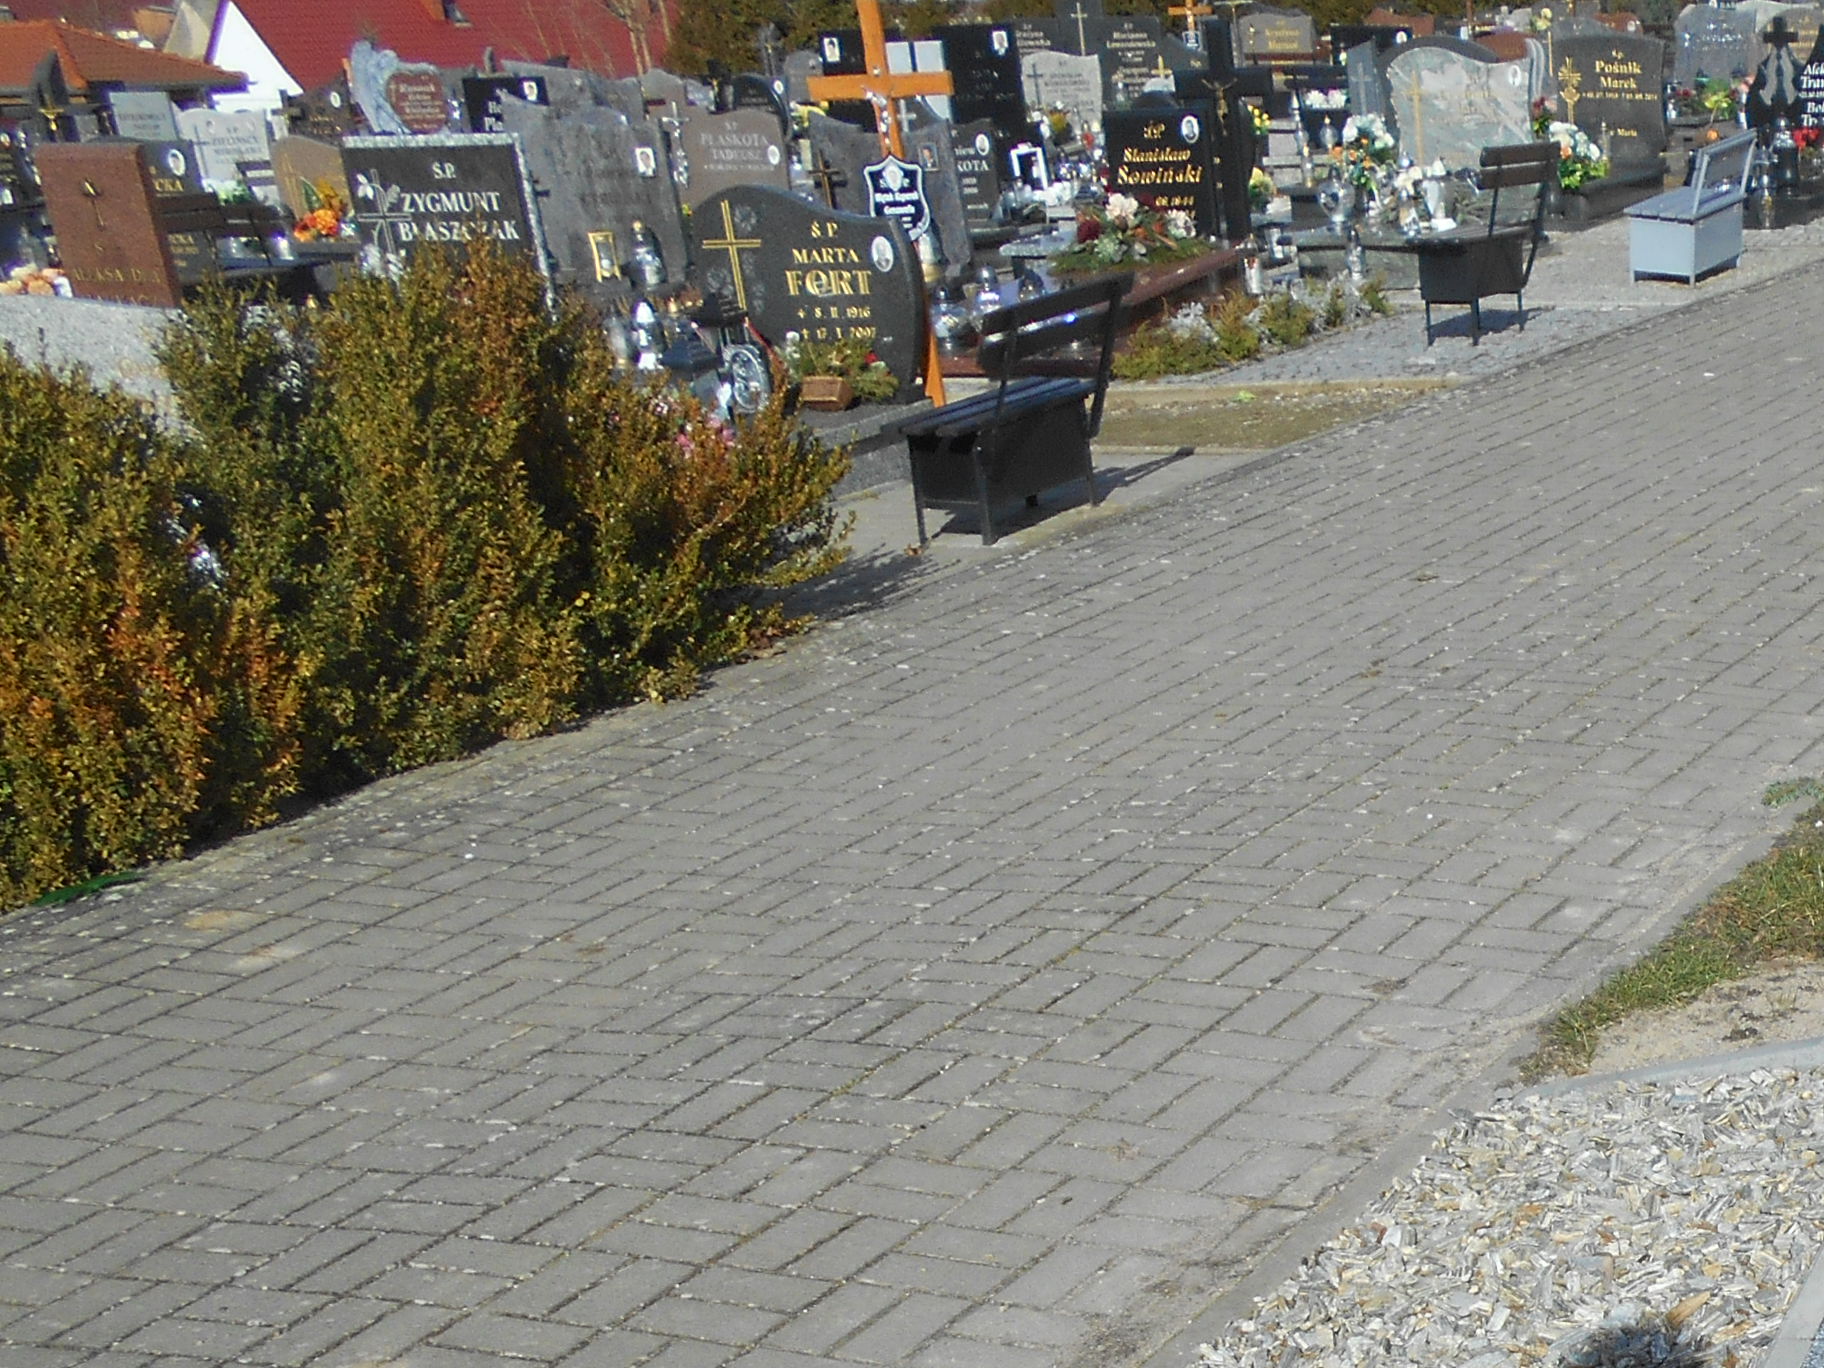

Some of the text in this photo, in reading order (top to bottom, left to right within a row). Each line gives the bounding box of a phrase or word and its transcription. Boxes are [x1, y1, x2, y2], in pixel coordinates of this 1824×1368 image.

[1595, 60, 1643, 74] Pośnik
[1600, 76, 1638, 89] Marek
[400, 191, 500, 213] ZYGMUNT
[791, 247, 860, 264] MARTA
[785, 269, 872, 296] FORT
